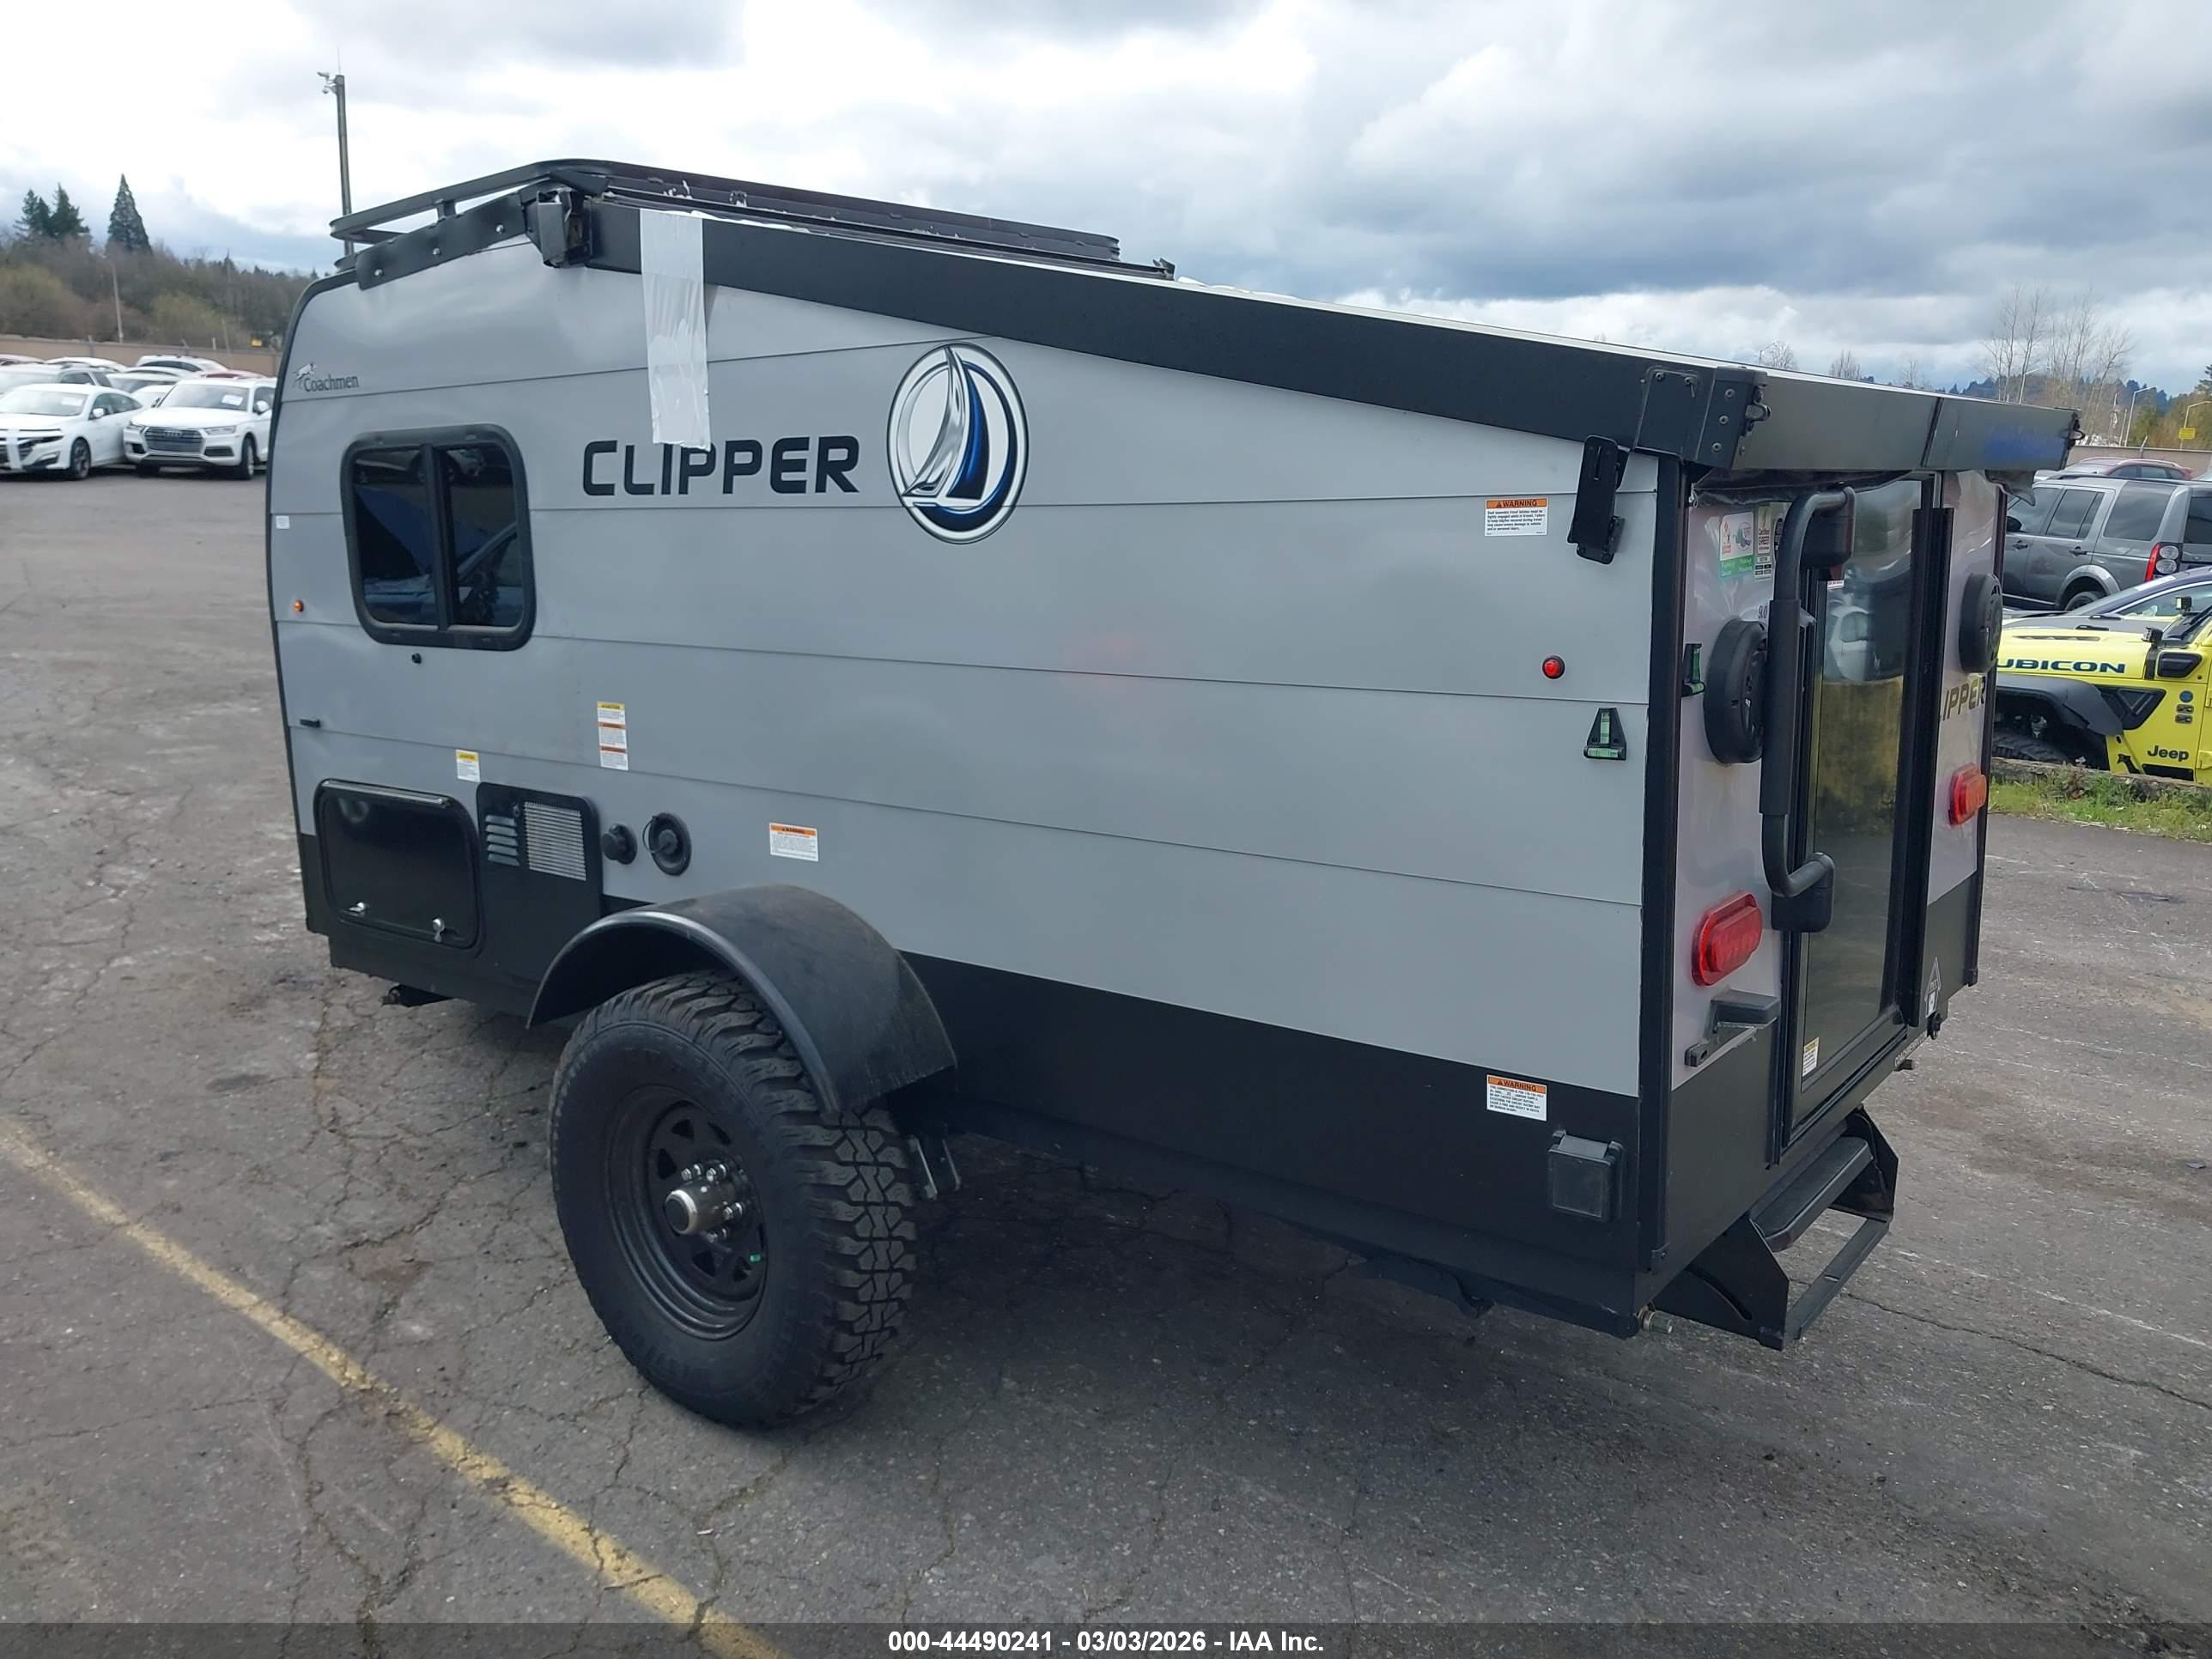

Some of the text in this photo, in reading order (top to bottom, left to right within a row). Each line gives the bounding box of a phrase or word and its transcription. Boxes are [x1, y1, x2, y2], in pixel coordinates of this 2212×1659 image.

[303, 374, 360, 392] Coachmen
[582, 435, 859, 496] CLIPPER
[1503, 500, 1538, 508] WARNING
[1996, 658, 2126, 674] UBICON
[1942, 676, 1986, 721] IPPER
[2147, 744, 2190, 762] Jeep
[1504, 1079, 1538, 1091] WARNING
